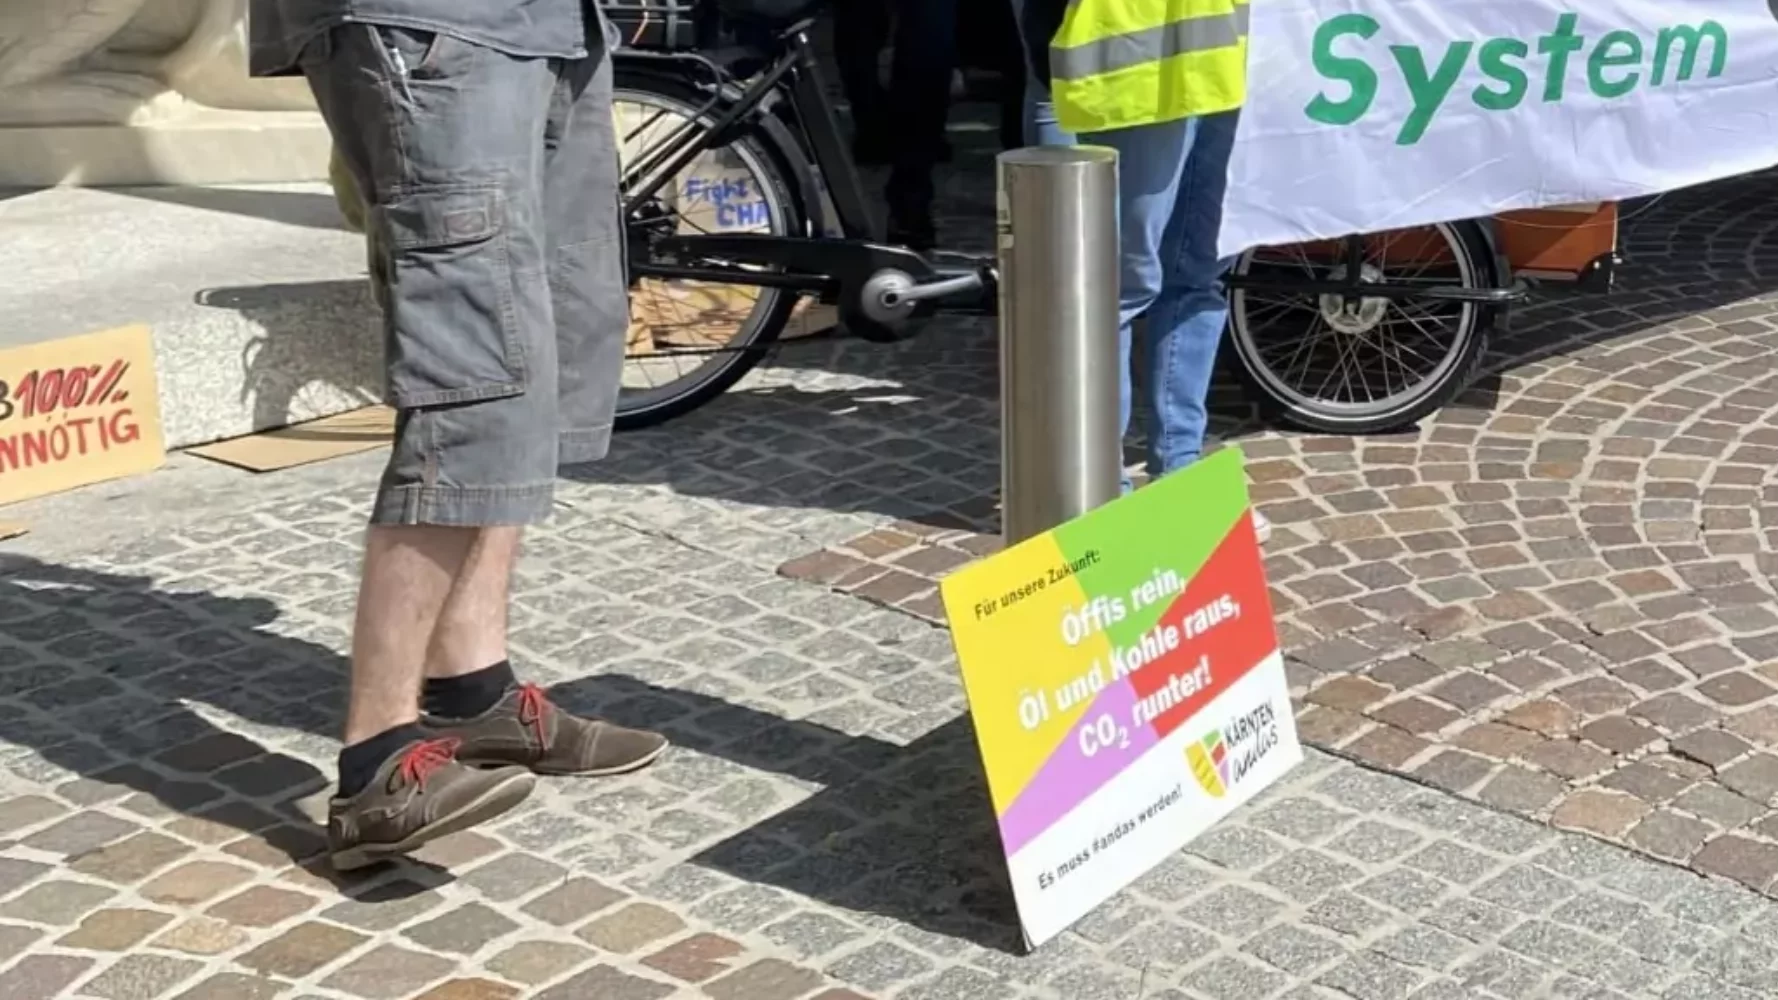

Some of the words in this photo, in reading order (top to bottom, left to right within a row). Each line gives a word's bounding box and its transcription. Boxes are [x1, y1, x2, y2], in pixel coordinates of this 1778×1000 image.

[1304, 12, 1728, 145] System
[13, 358, 131, 419] 100%
[974, 598, 998, 621] Für
[1001, 577, 1047, 608] unsere
[1048, 549, 1101, 585] Zukunft:
[1061, 594, 1127, 645] Öffis
[1130, 566, 1186, 612] rein,
[1018, 687, 1049, 730] Öl
[1055, 659, 1107, 713] und
[1109, 624, 1180, 681] Kohle
[1183, 593, 1241, 640] raus,
[1132, 654, 1213, 728] runter!
[1224, 698, 1275, 750] KÄRNTEN
[1037, 870, 1054, 890] Es
[1057, 849, 1090, 878] muss
[1138, 783, 1183, 826] werden!
